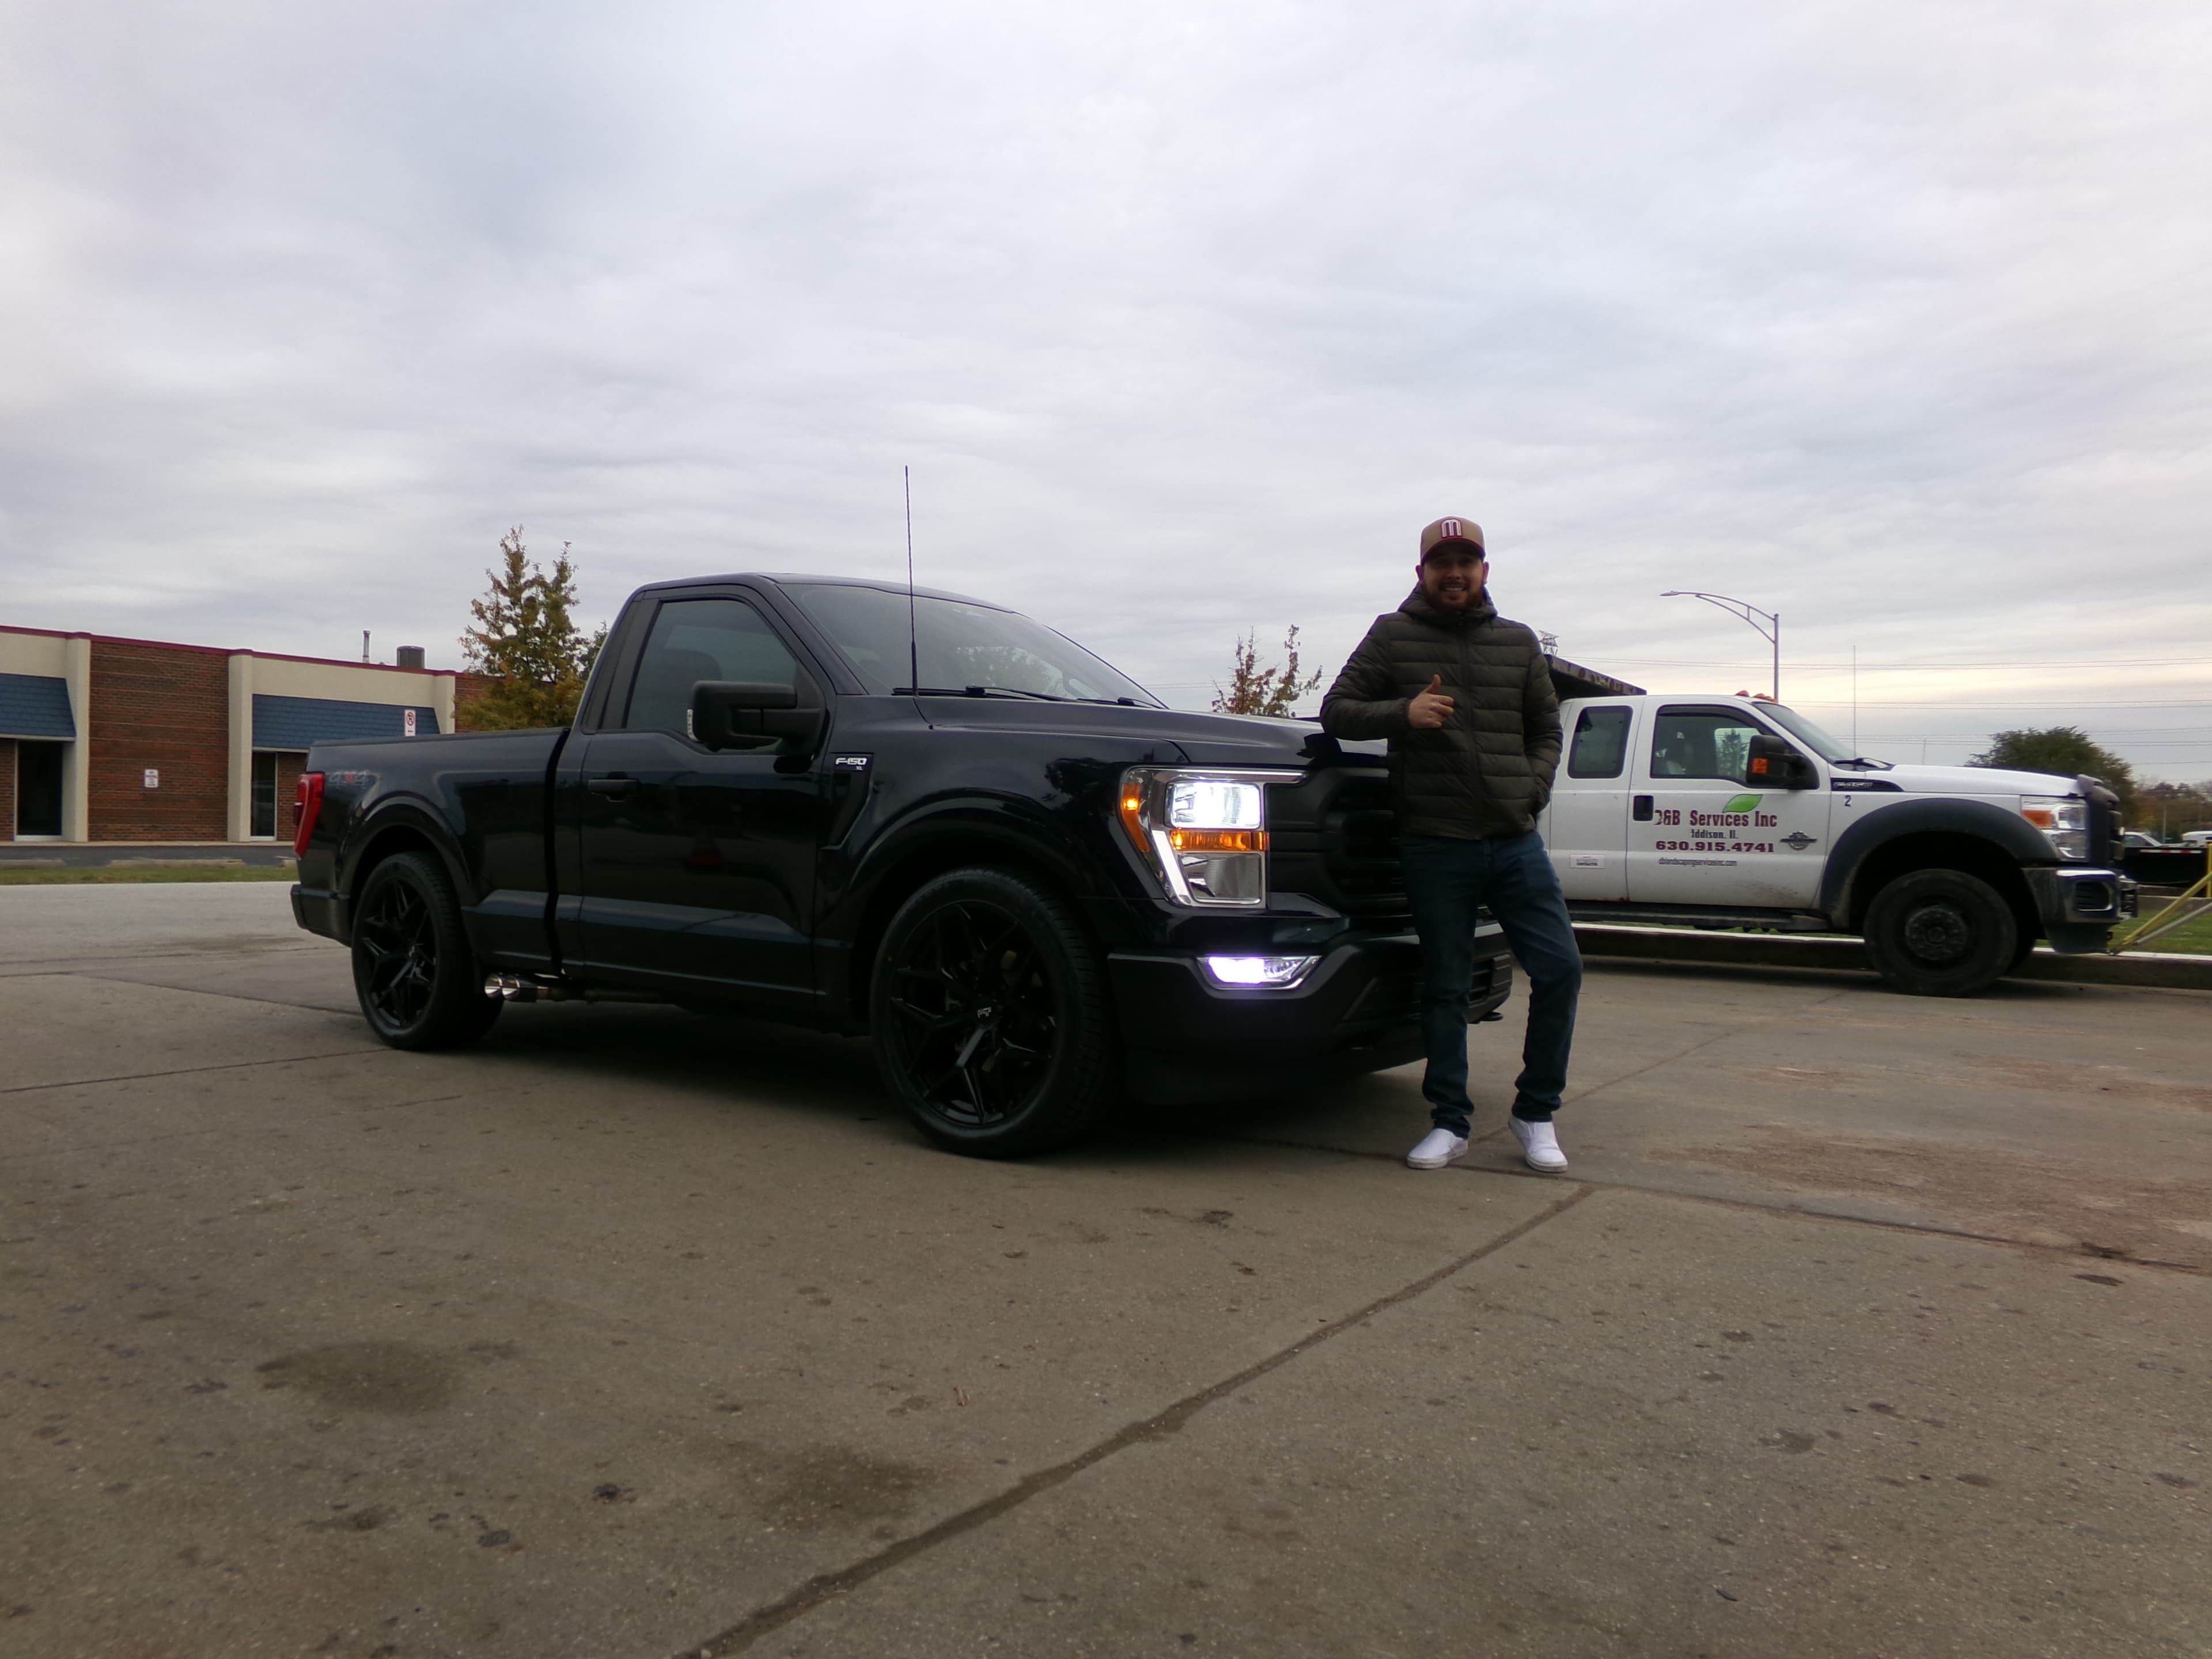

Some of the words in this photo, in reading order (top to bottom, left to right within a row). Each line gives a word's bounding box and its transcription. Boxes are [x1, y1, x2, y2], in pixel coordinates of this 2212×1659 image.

[835, 757, 868, 765] F-150
[1844, 795, 1851, 806] 2
[1690, 809, 1749, 827] Services
[1754, 810, 1778, 827] Inc
[1656, 840, 1774, 853] 630.915.4741
